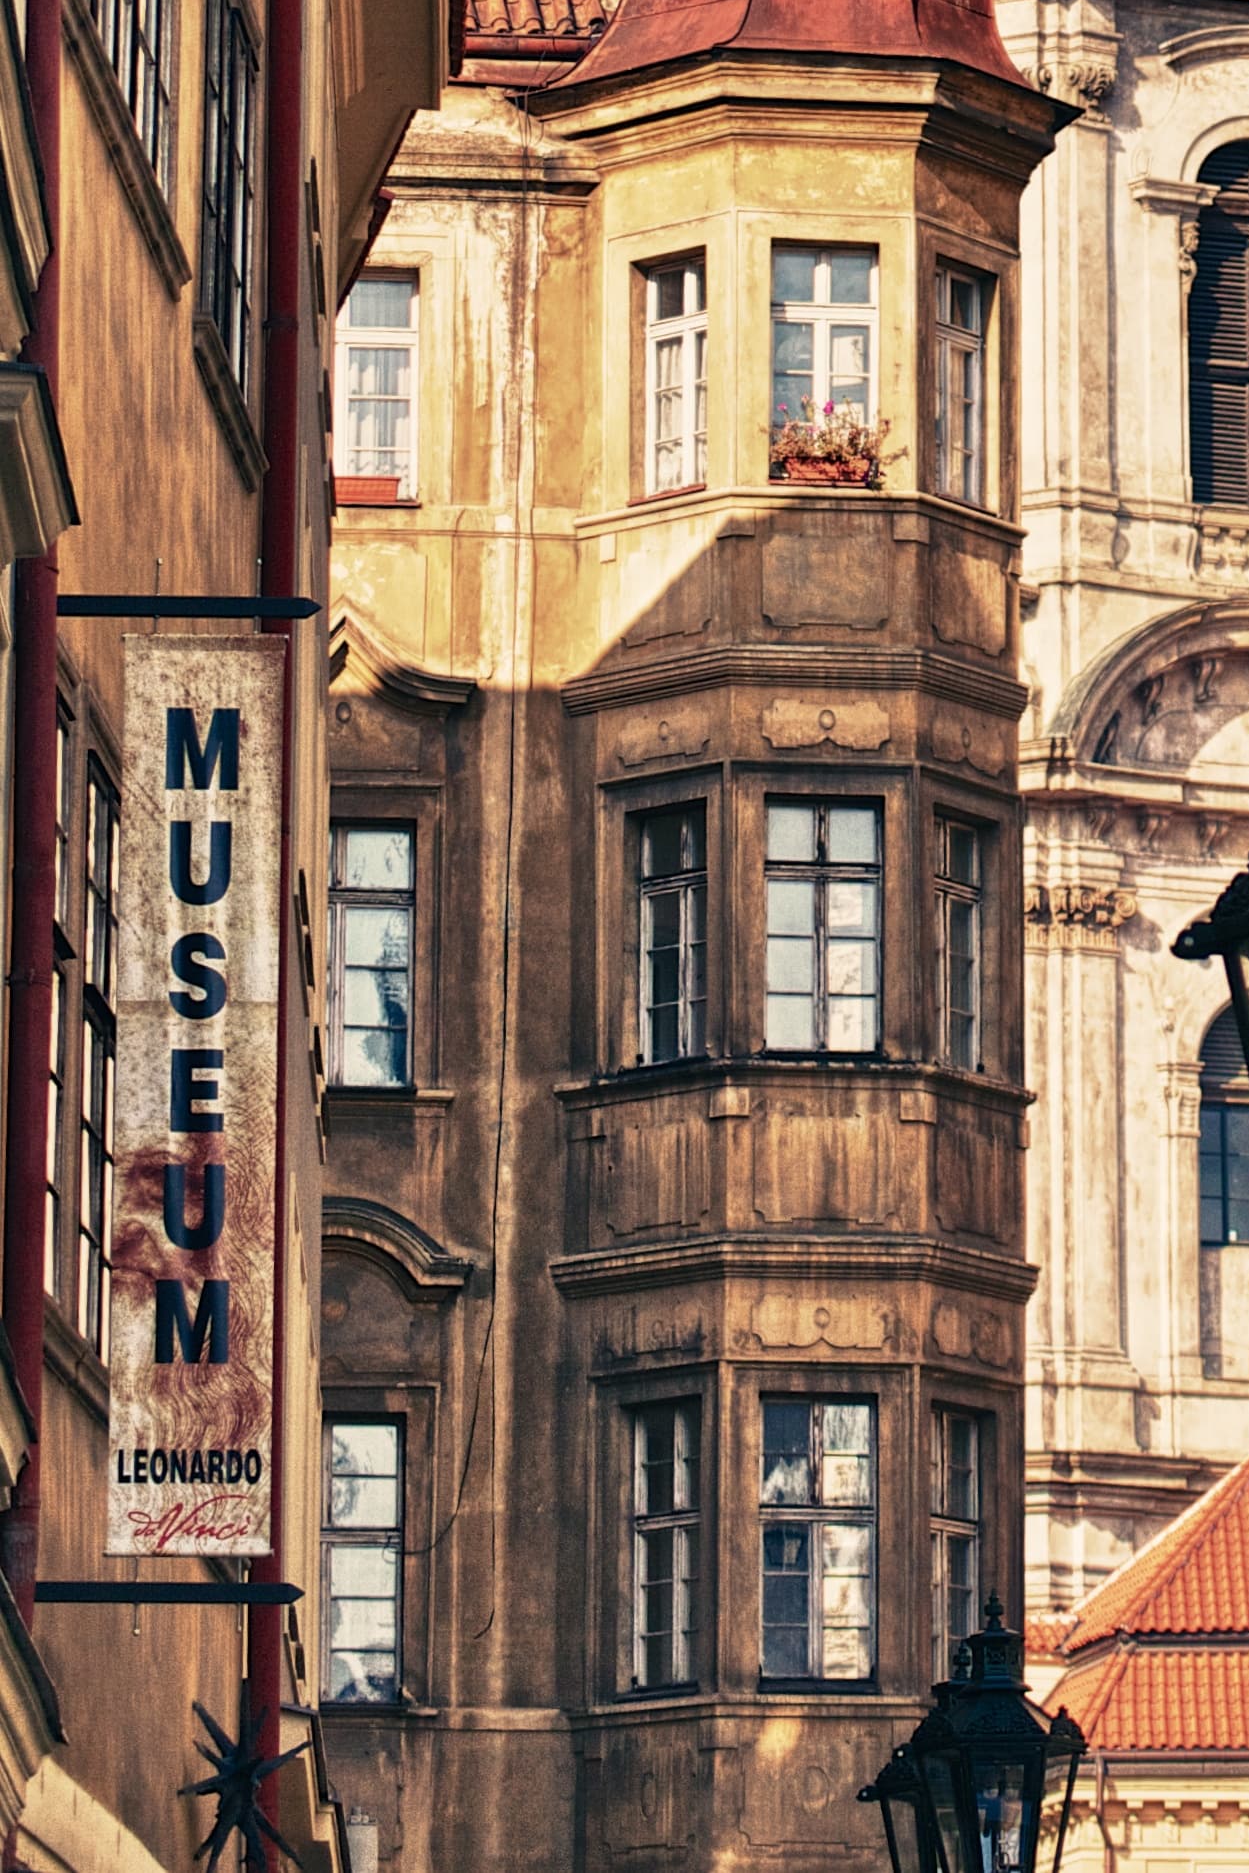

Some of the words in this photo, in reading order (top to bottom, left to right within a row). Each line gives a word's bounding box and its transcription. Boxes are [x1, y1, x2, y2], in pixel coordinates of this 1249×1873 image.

[154, 707, 241, 1364] MUSEUM
[117, 1448, 262, 1485] LEONARDO
[127, 1511, 160, 1537] da
[156, 1494, 251, 1548] Vinci
